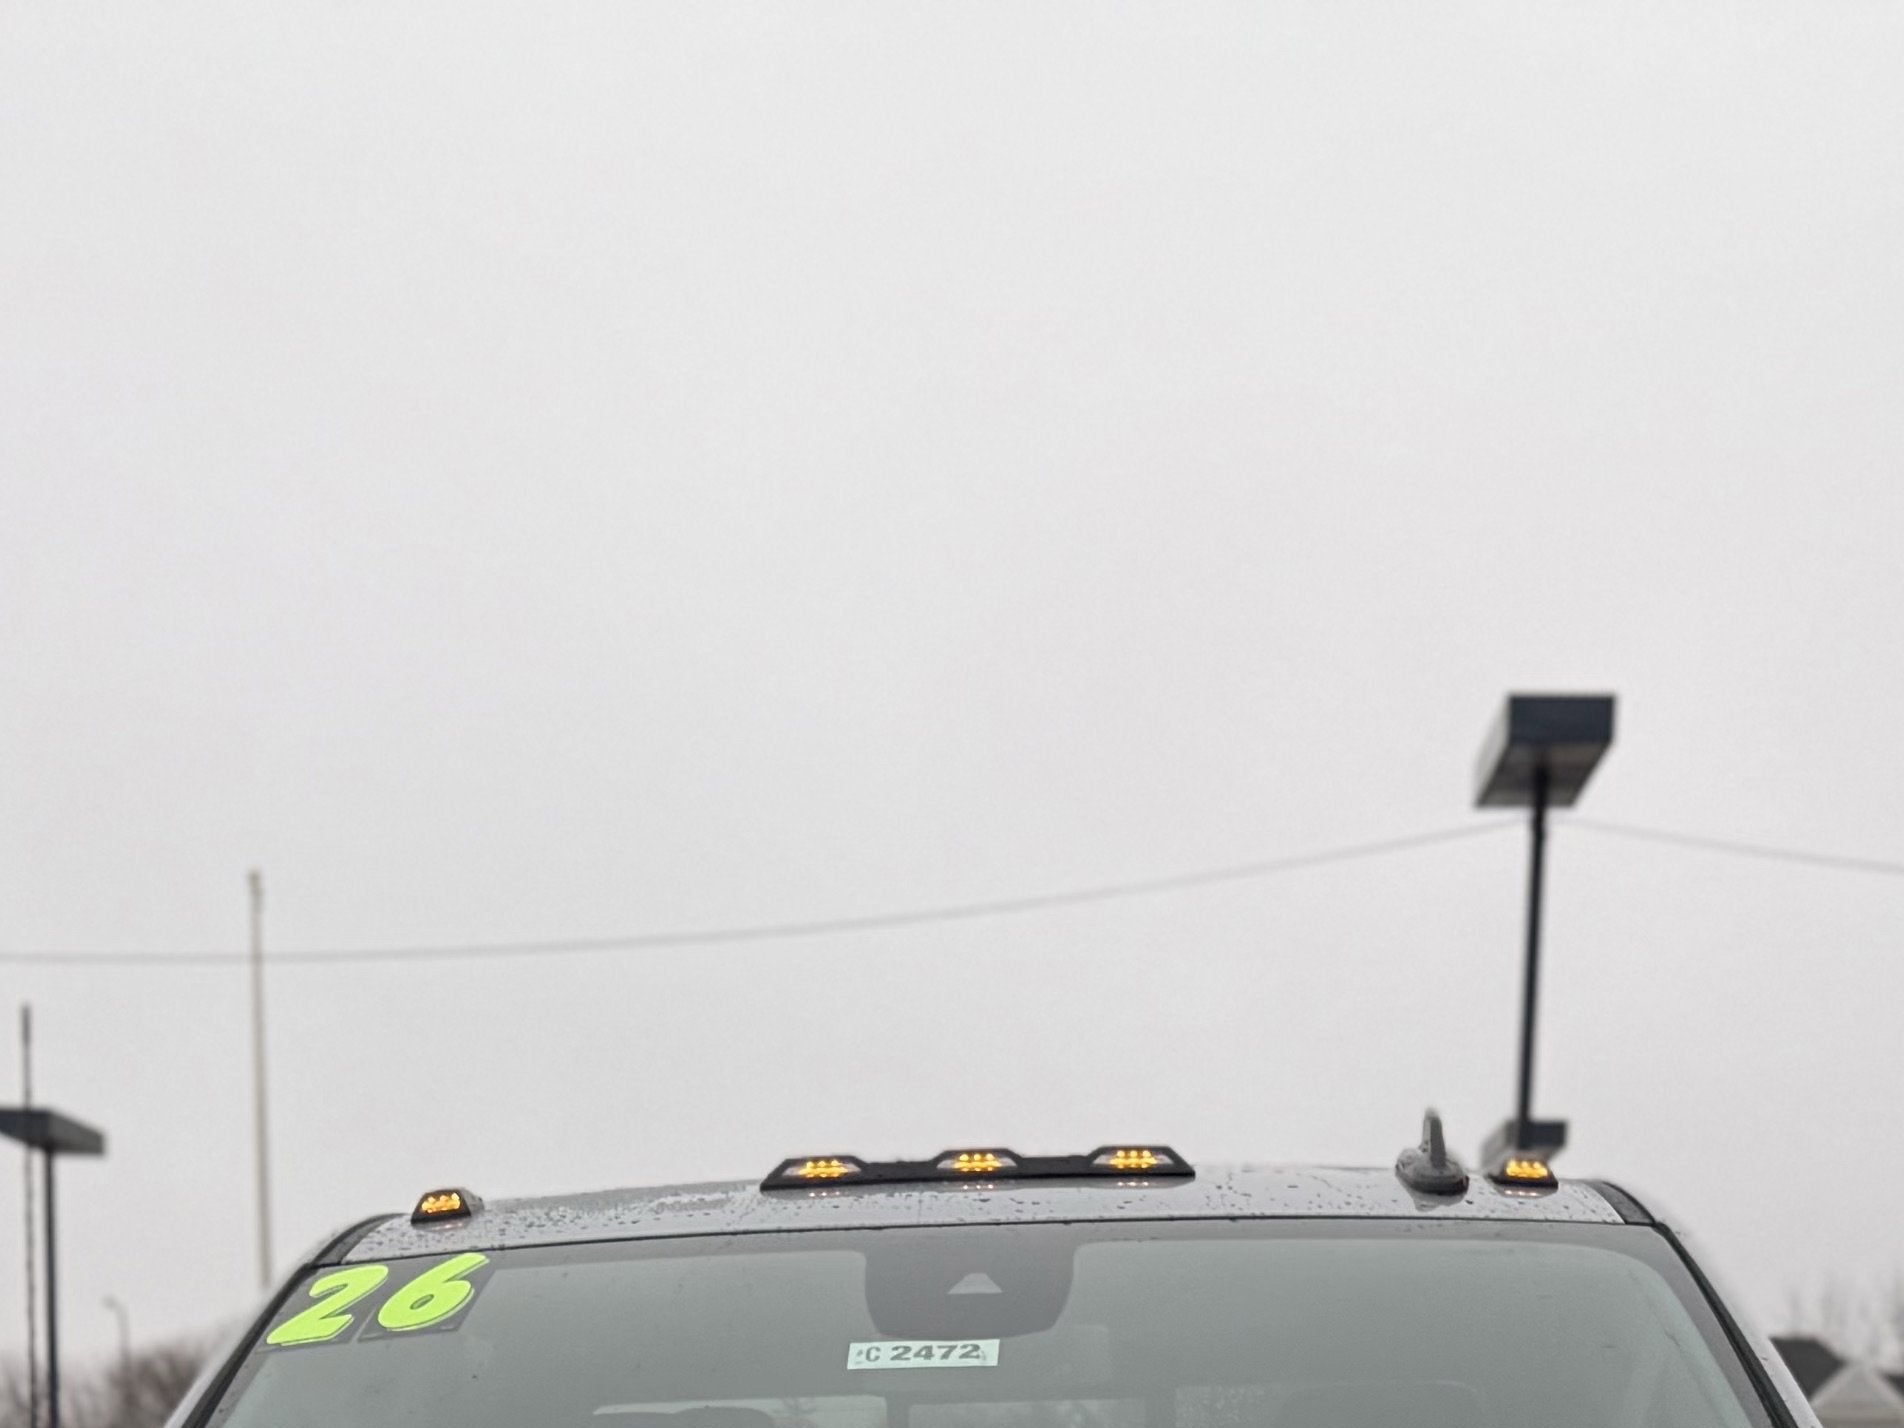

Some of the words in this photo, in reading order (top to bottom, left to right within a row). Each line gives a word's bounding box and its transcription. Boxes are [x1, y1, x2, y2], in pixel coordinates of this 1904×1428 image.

[267, 1252, 489, 1346] 26
[865, 1346, 881, 1362] C
[890, 1344, 981, 1361] 2472
